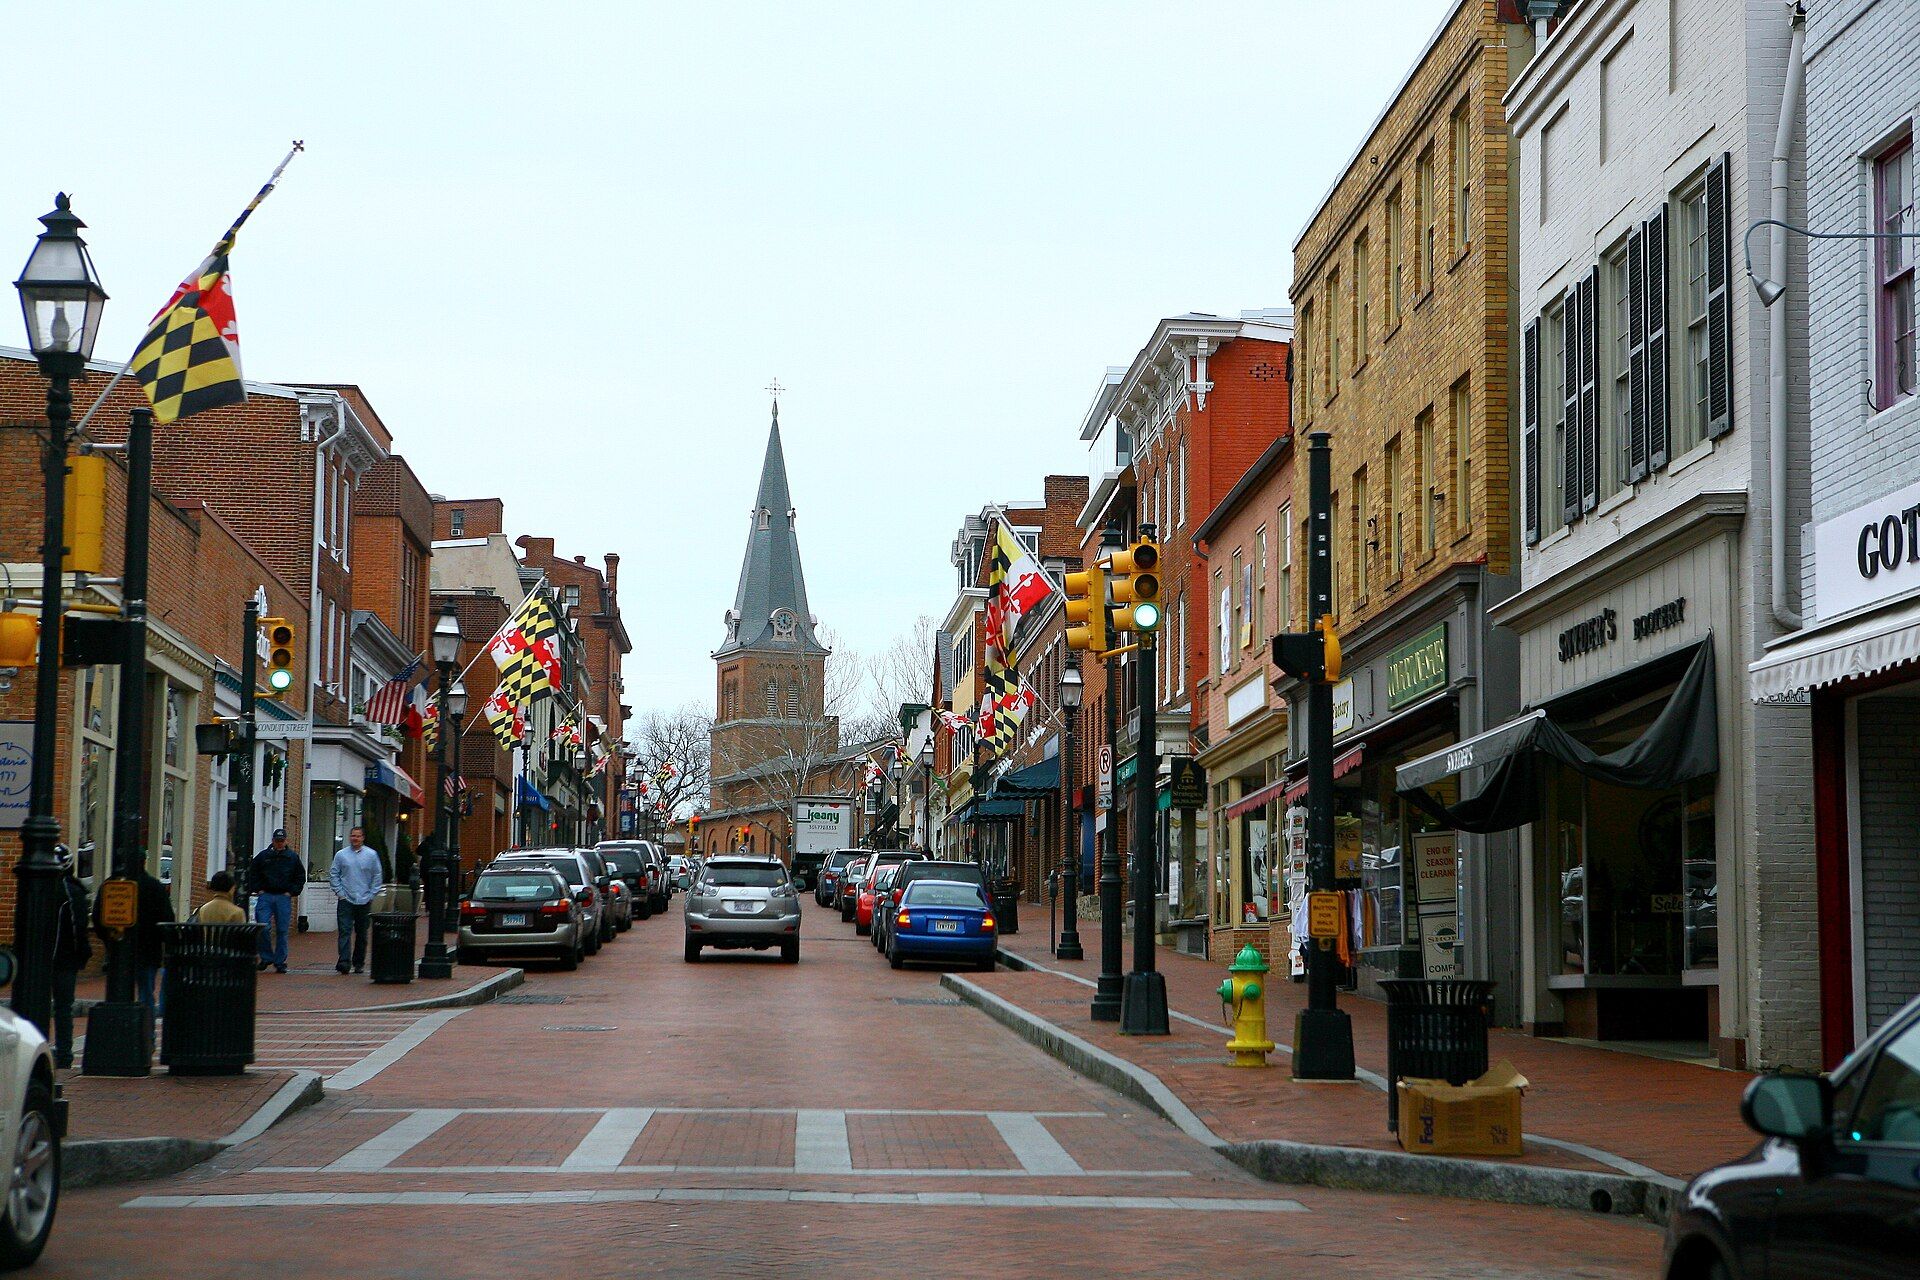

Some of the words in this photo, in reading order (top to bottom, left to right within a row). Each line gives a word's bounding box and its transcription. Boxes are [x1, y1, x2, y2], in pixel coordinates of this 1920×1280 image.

[1857, 503, 1920, 579] GOT
[1558, 607, 1617, 663] SNYDER'S
[1632, 597, 1686, 641] BOOTERY
[1333, 700, 1349, 719] actory
[257, 723, 285, 732] CONDUIT
[286, 723, 309, 732] STREET
[1426, 847, 1440, 855] END
[1442, 846, 1452, 854] OF
[1426, 858, 1454, 867] SEASON
[1428, 965, 1456, 973] COMF
